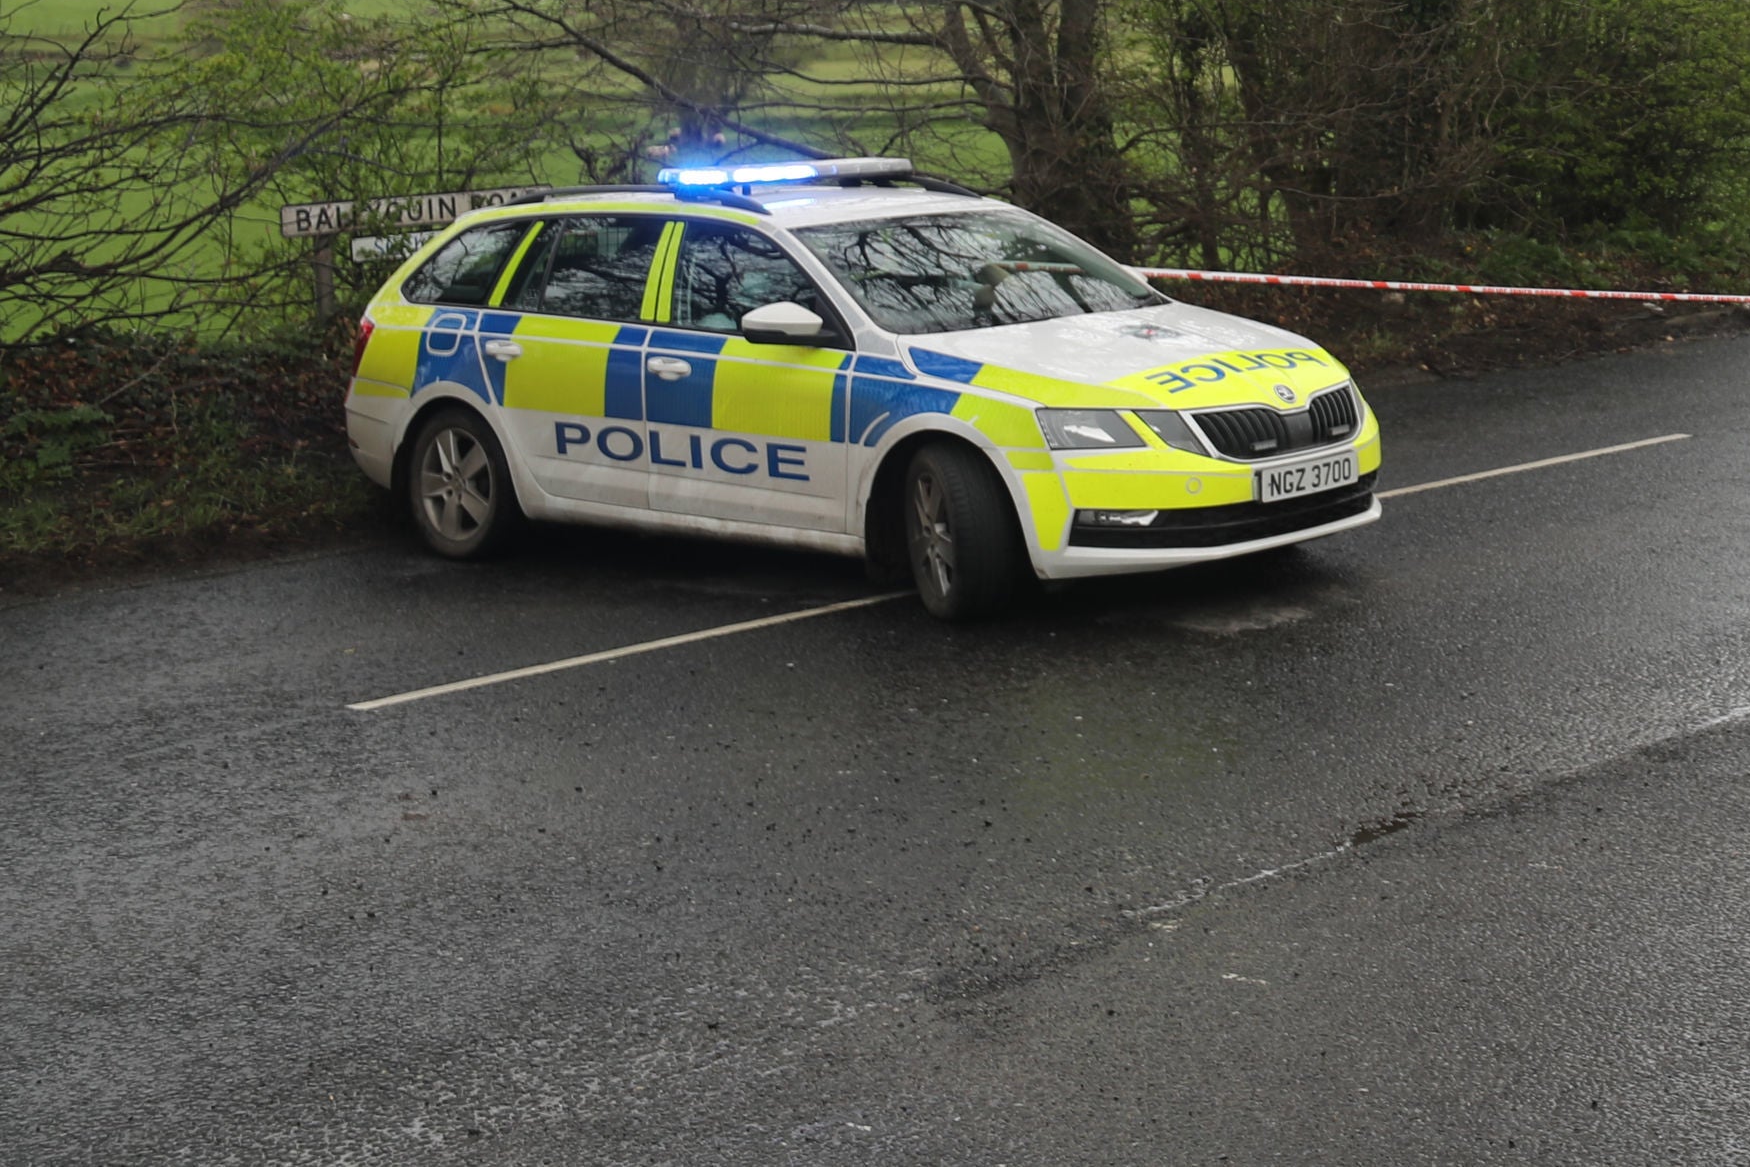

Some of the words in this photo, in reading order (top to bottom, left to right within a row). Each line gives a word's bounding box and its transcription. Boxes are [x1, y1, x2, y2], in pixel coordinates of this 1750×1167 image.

[554, 421, 811, 482] POLICE
[1269, 467, 1307, 497] NGZ
[1311, 458, 1351, 489] 3700
